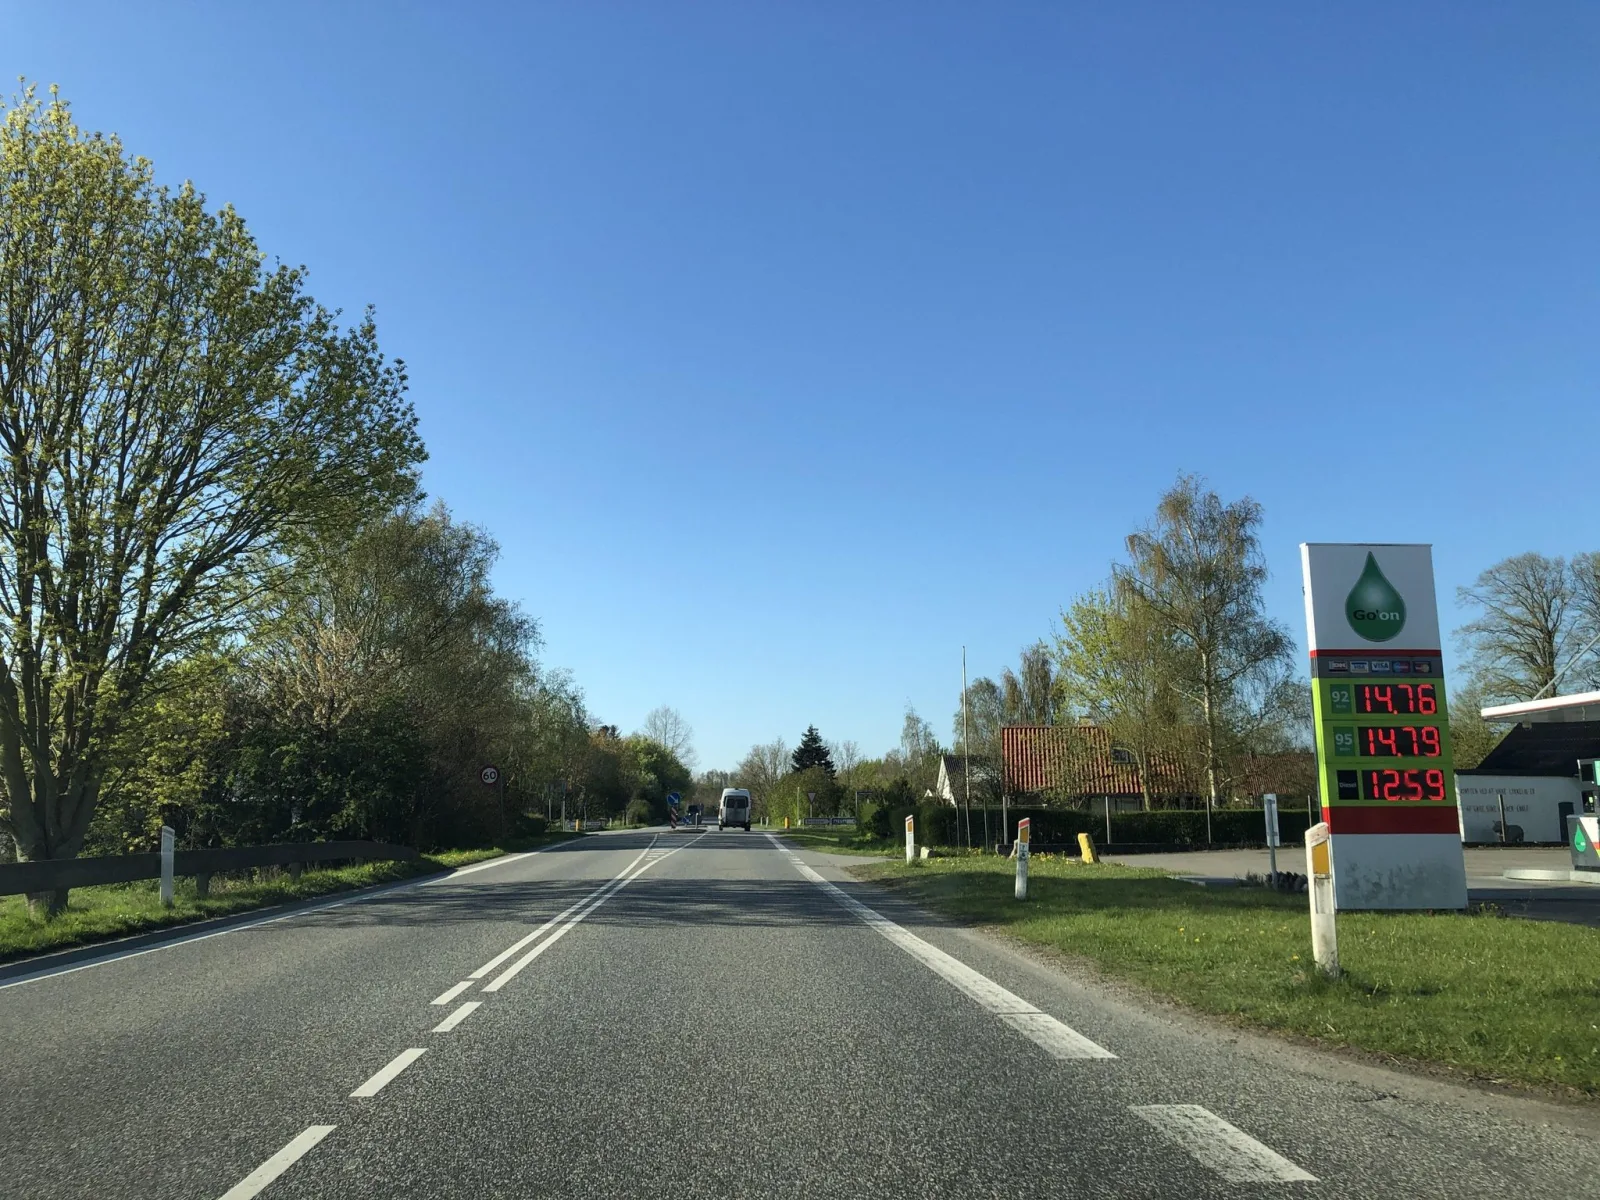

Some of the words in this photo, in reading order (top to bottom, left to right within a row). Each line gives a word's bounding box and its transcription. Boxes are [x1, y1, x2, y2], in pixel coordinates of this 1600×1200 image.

[1353, 609, 1400, 621] Go'on
[1331, 690, 1350, 703] 92
[1364, 683, 1436, 715] 14.76
[1335, 733, 1353, 746] 95
[1368, 726, 1441, 757] 14.79
[483, 770, 497, 781] 60
[1339, 781, 1357, 789] Diesel
